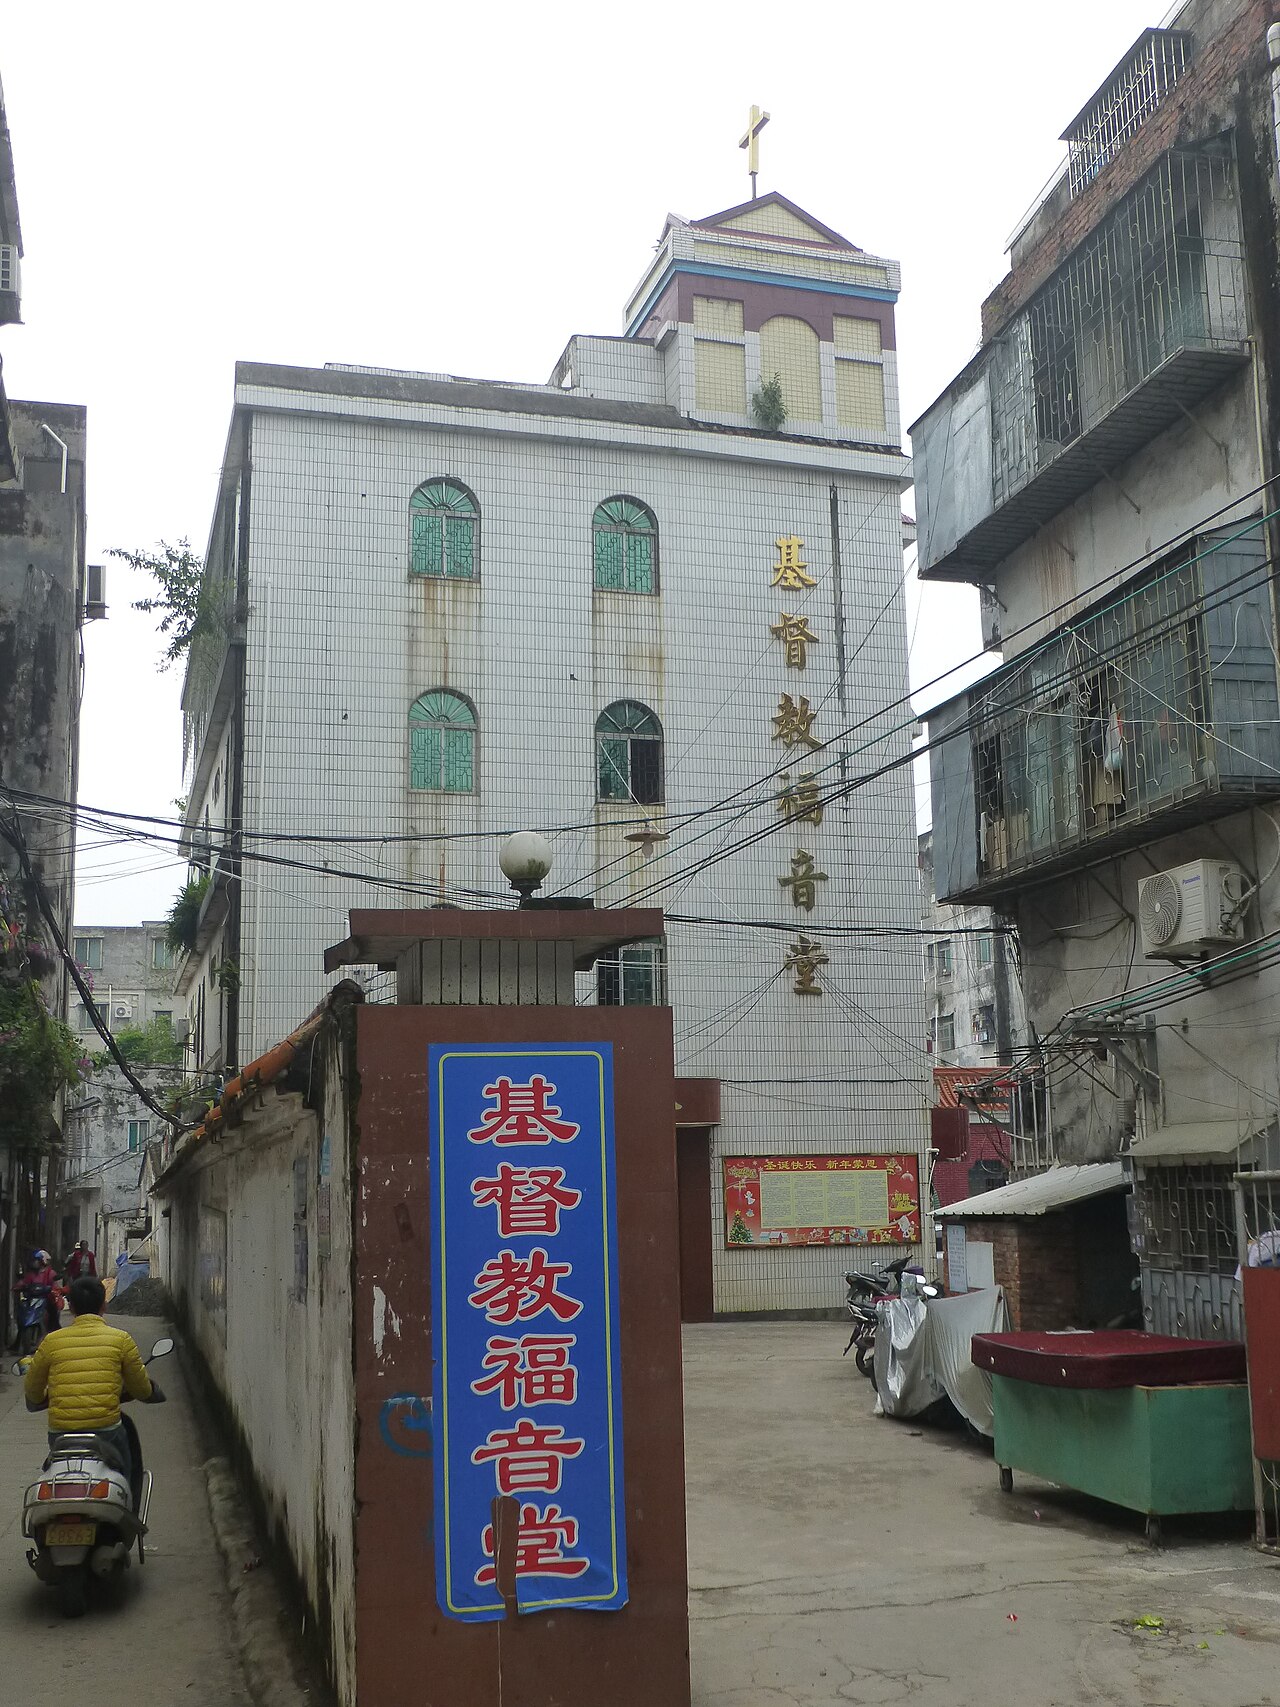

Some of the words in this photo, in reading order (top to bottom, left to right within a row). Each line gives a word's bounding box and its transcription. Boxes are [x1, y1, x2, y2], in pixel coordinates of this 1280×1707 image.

[769, 534, 829, 996] 基督教福音堂
[466, 1074, 590, 1586] 基督教福音堂
[764, 1160, 817, 1170] 圣诞快乐
[826, 1159, 877, 1169] 新年蒙恩
